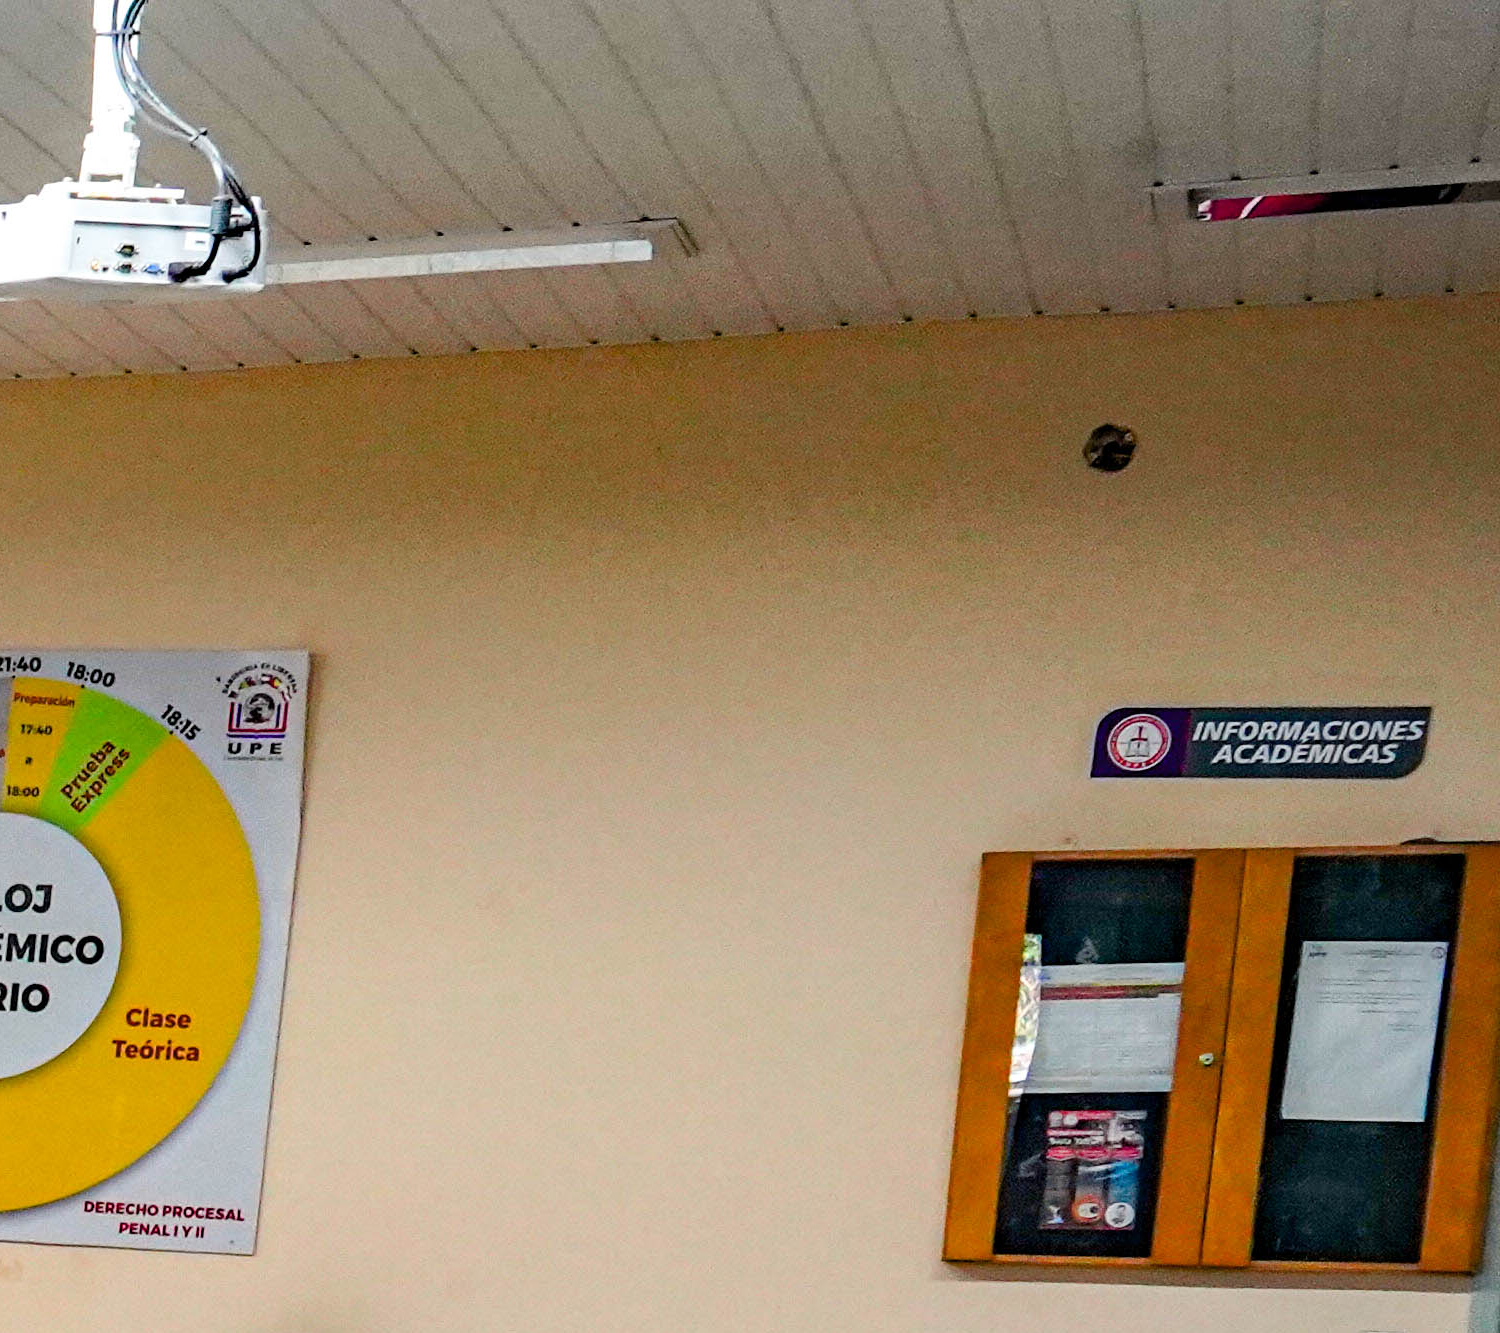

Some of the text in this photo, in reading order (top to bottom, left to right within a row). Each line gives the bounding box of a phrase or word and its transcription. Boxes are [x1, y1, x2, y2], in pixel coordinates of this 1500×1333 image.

[66, 661, 116, 688] 18:00
[13, 692, 76, 708] Preparación
[20, 723, 53, 736] 17:40
[161, 703, 201, 741] 18:15
[1192, 720, 1425, 742] INFORMACIONES
[227, 742, 283, 755] UPE
[1211, 738, 1398, 764] ACADÉMICAS
[60, 741, 116, 799] Prueba
[70, 749, 132, 813] Express
[6, 785, 40, 797] 18:00
[124, 1007, 192, 1030] Clase
[111, 1037, 200, 1063] Teórica
[83, 1200, 245, 1222] DERECHO PROCESAL
[118, 1221, 168, 1237] PENAL
[182, 1224, 192, 1238] Y
[195, 1225, 206, 1239] II
